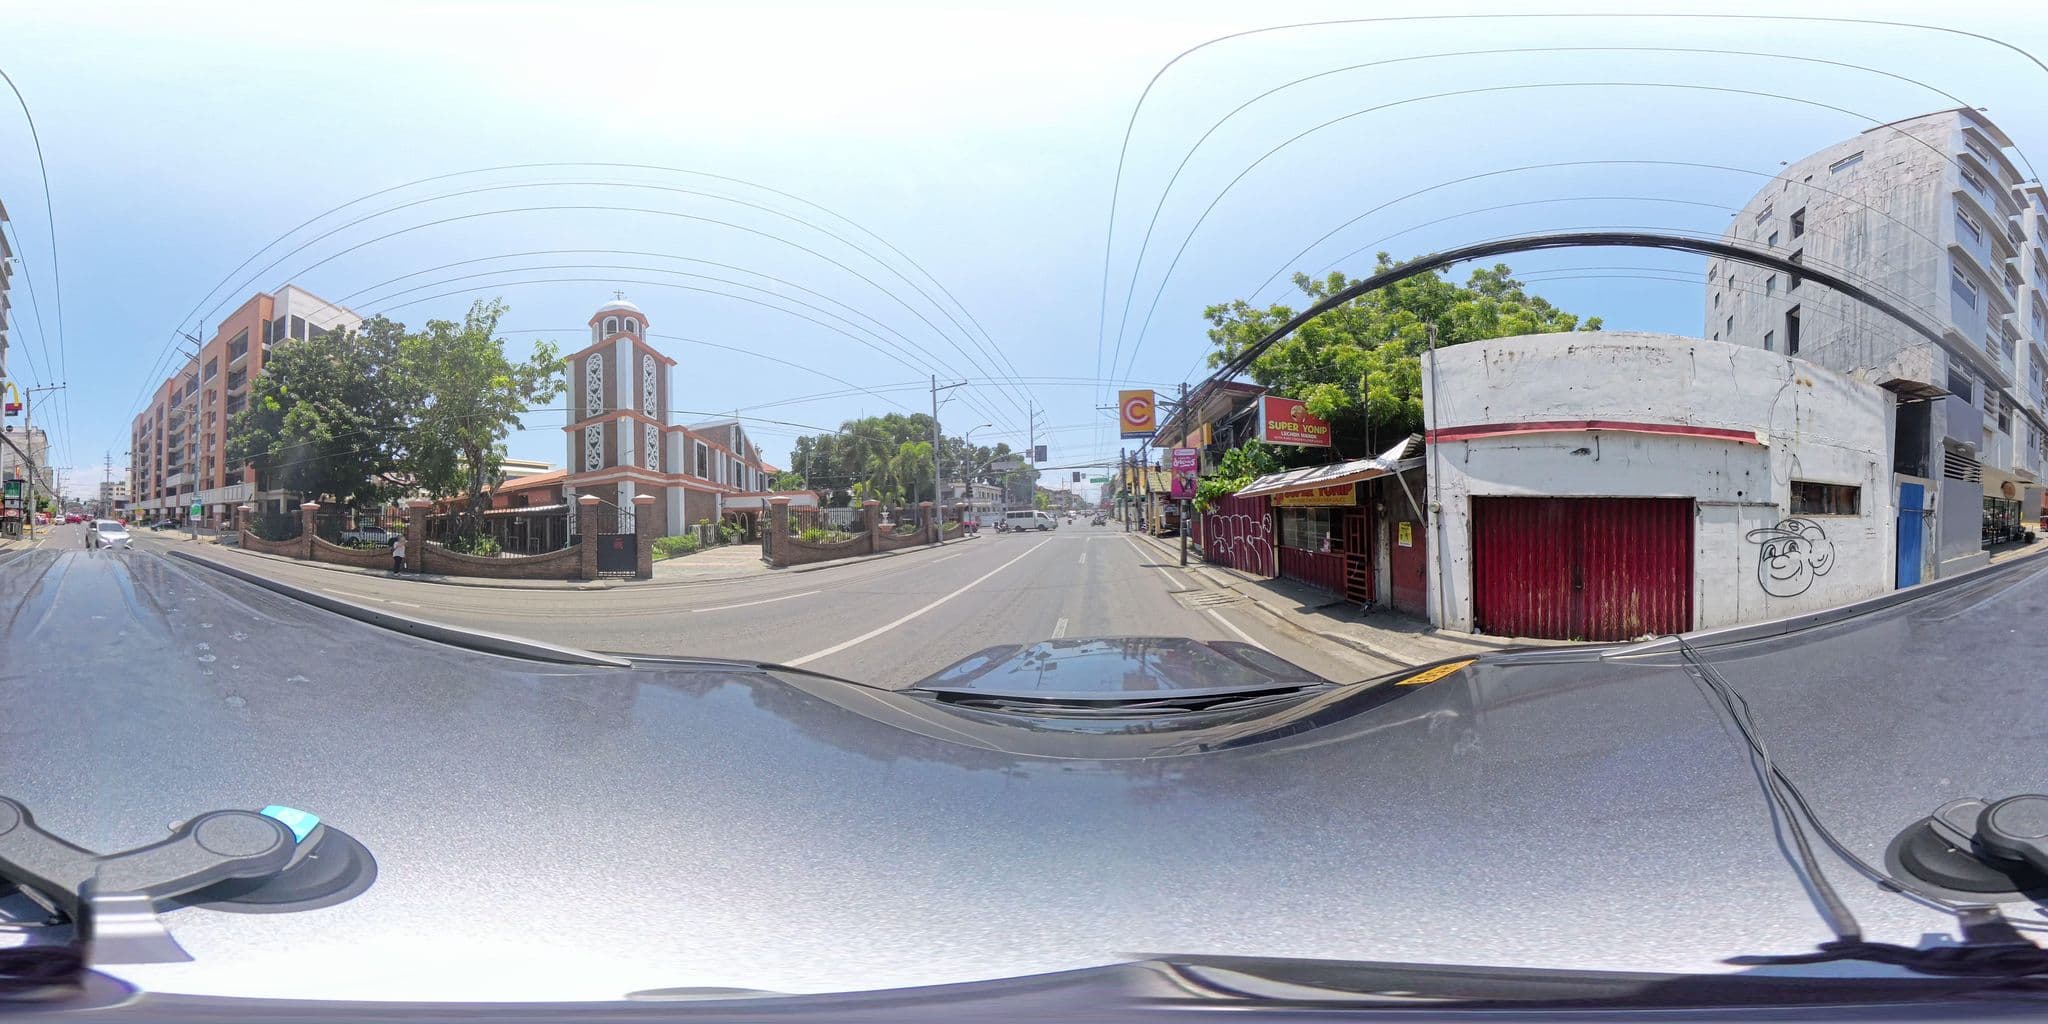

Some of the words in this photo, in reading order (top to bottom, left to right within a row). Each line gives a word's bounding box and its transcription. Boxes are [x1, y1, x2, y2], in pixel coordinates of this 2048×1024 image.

[1123, 397, 1150, 426] C
[1268, 420, 1299, 431] SUPER
[1303, 424, 1327, 434] YONIP
